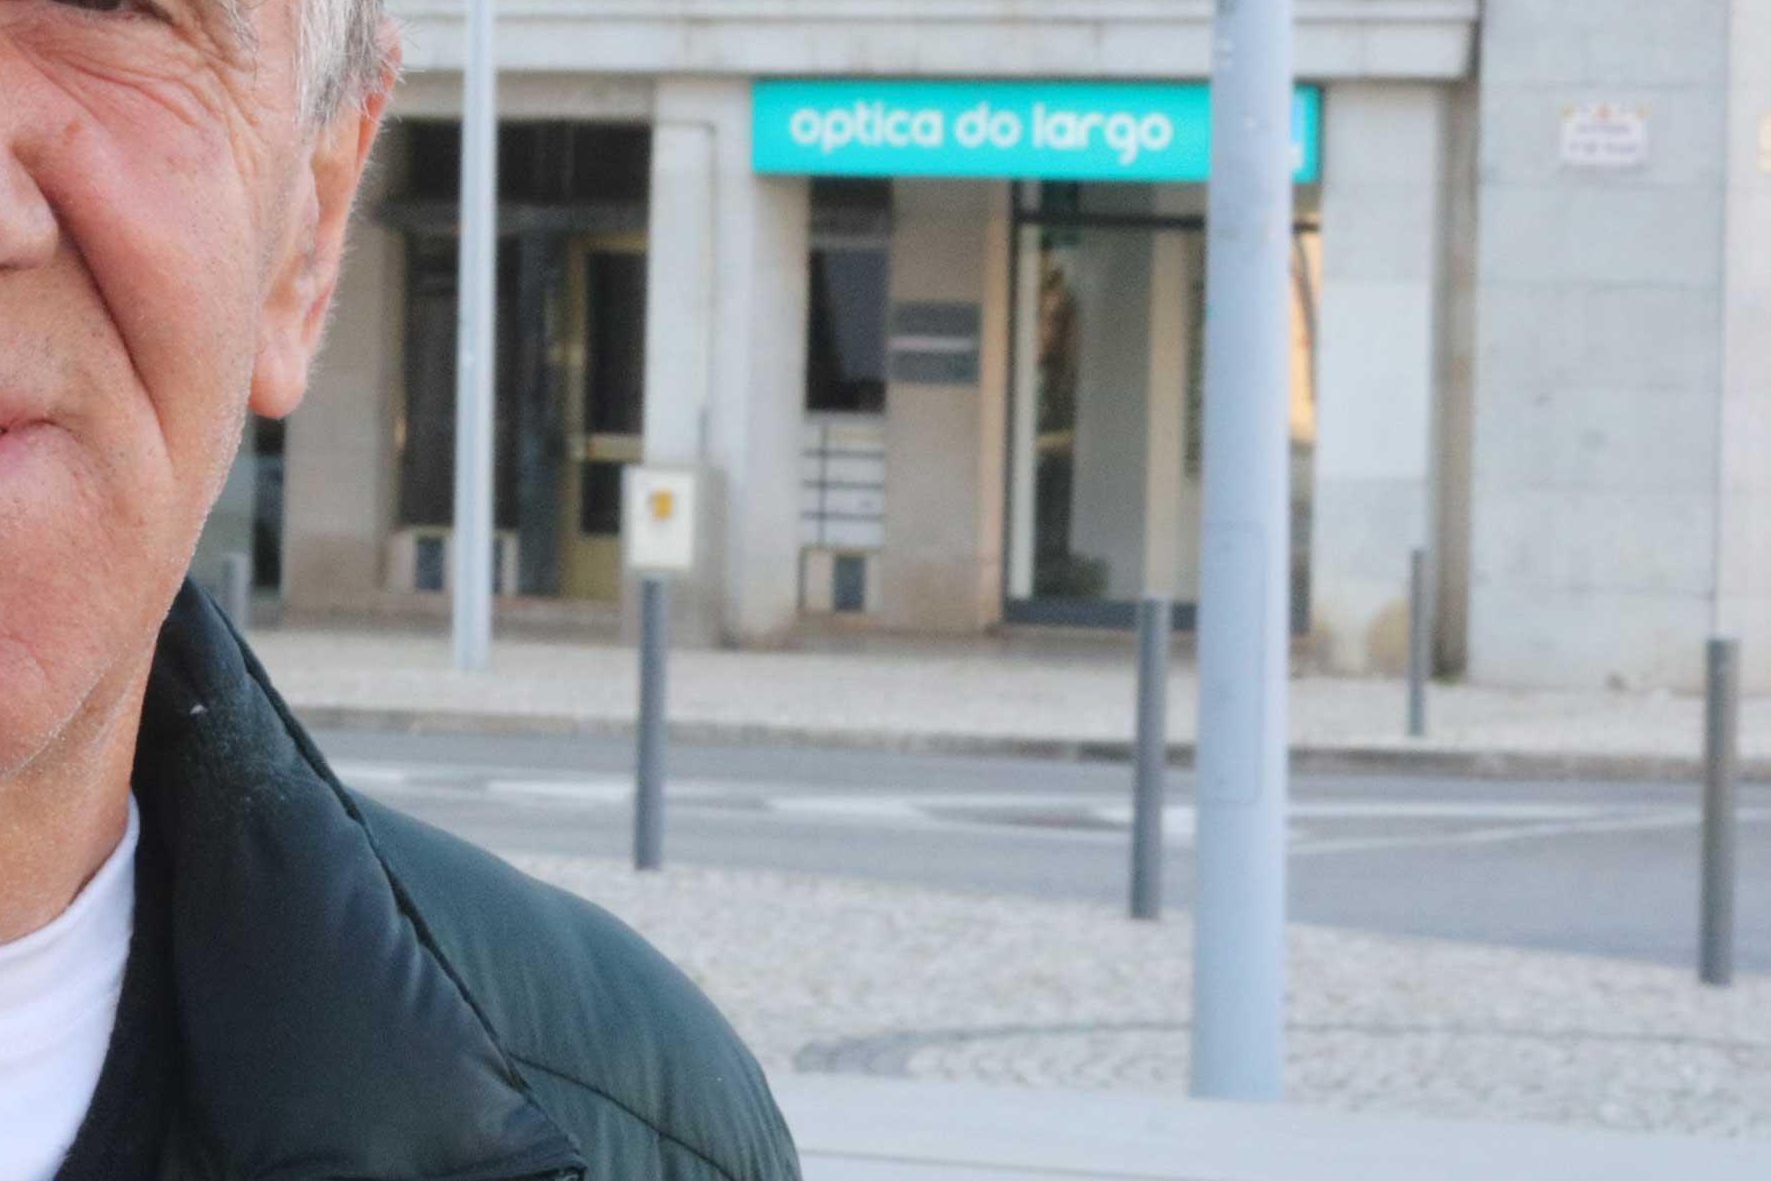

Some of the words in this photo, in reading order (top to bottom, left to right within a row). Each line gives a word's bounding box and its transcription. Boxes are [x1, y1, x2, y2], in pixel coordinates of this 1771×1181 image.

[788, 101, 944, 153] optica
[953, 102, 1023, 148] do
[1032, 103, 1174, 165] largo
